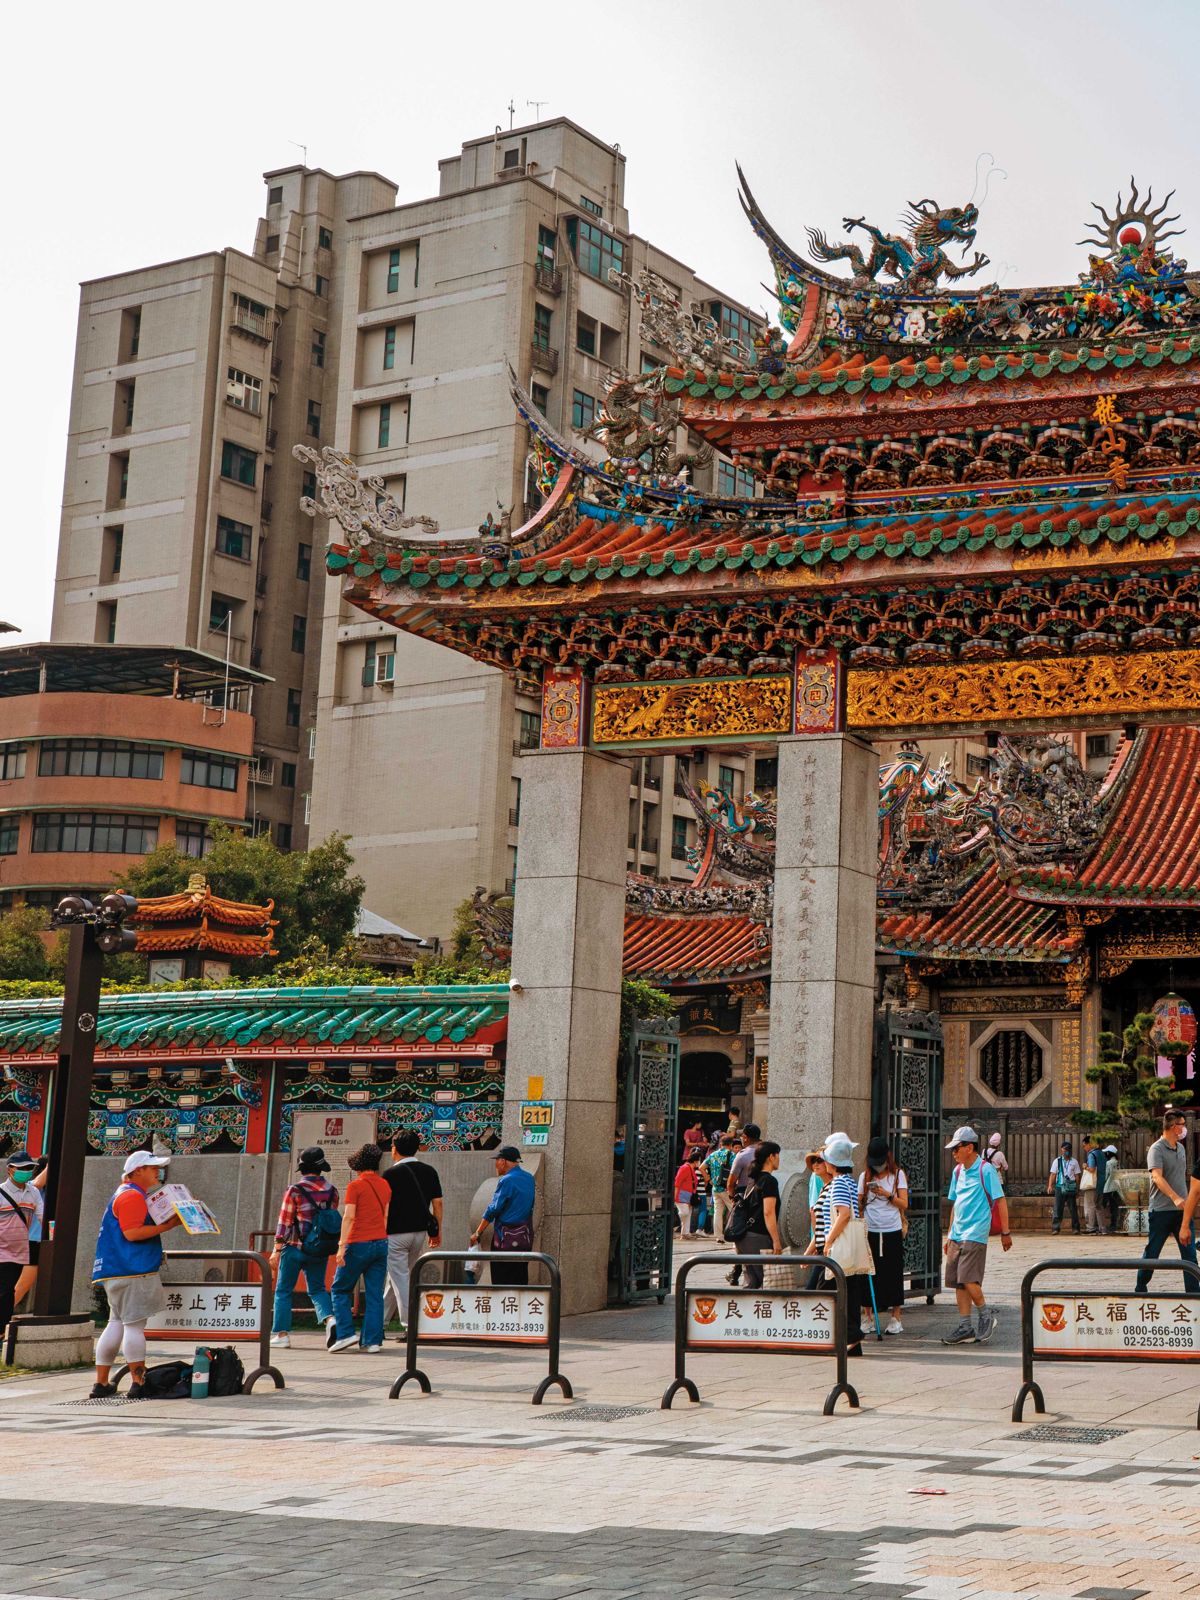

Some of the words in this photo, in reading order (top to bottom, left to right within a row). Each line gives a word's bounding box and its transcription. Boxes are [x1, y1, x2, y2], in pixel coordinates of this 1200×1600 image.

[1093, 393, 1131, 489] 龍山寺
[525, 1111, 548, 1123] 211
[531, 1134, 545, 1143] 211
[166, 1293, 257, 1312] 禁止停車
[451, 1296, 544, 1315] 良福保全
[725, 1300, 830, 1321] 良福保全
[1075, 1303, 1192, 1323] 良福保全
[1123, 1336, 1194, 1348] 02-2523-8939
